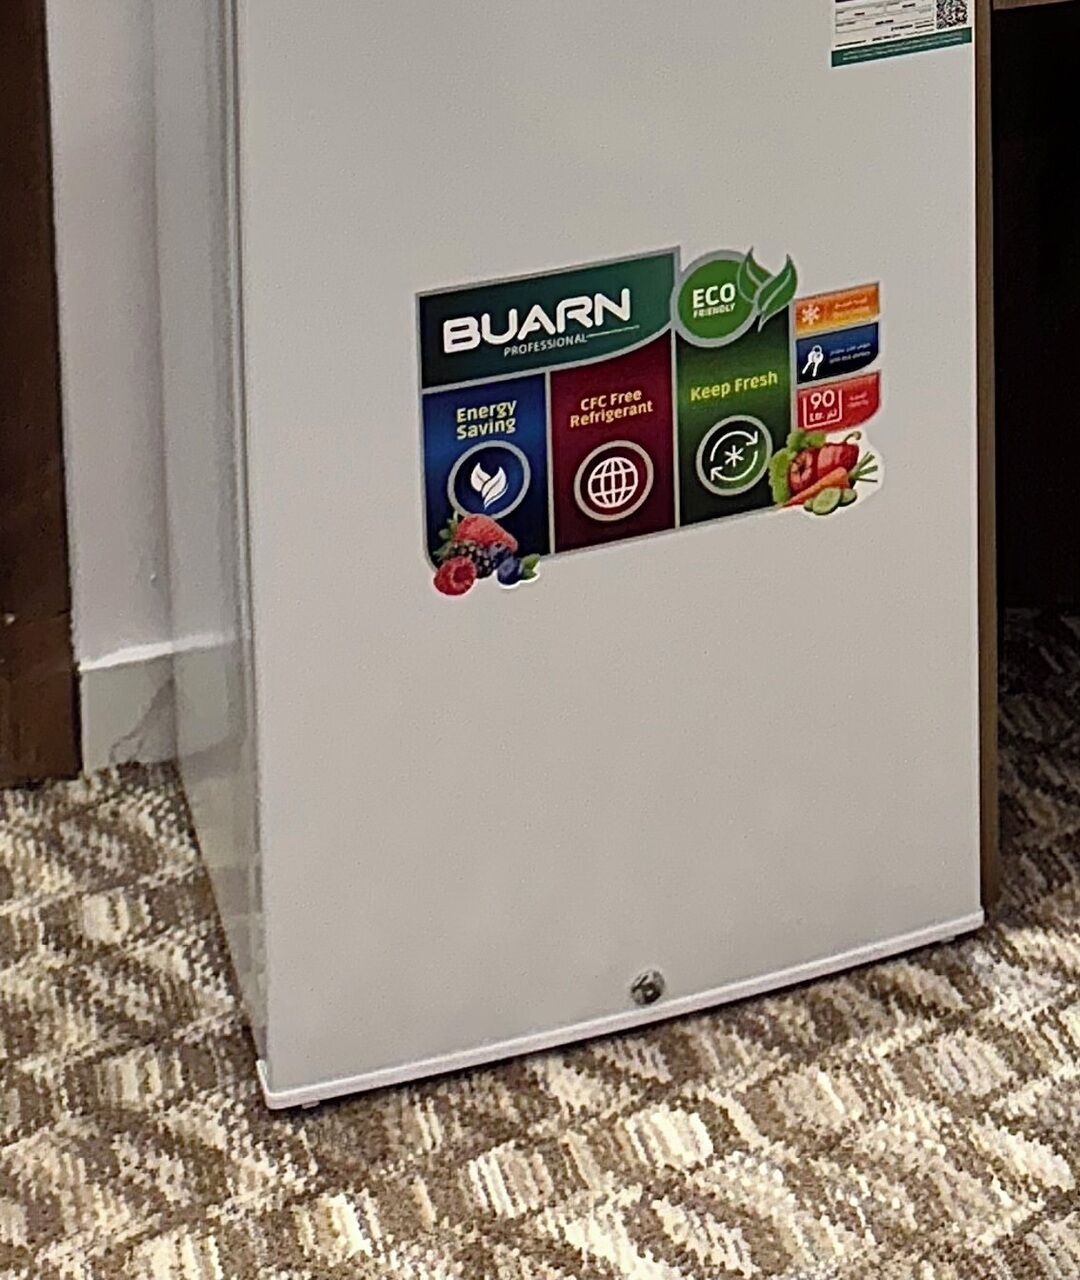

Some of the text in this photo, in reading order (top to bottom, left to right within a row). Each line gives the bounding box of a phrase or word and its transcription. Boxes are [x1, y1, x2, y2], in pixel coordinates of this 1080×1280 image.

[692, 282, 736, 309] ECO
[443, 287, 631, 354] BUARN
[692, 302, 736, 319] FRIENDLY
[504, 334, 588, 358] PROFESSIONAL
[690, 371, 778, 401] Keep Fresh
[580, 389, 642, 411] CFC Free
[810, 389, 836, 410] 90
[456, 400, 518, 423] Energy
[570, 400, 654, 429] Refrigerant
[456, 417, 516, 440] Saving
